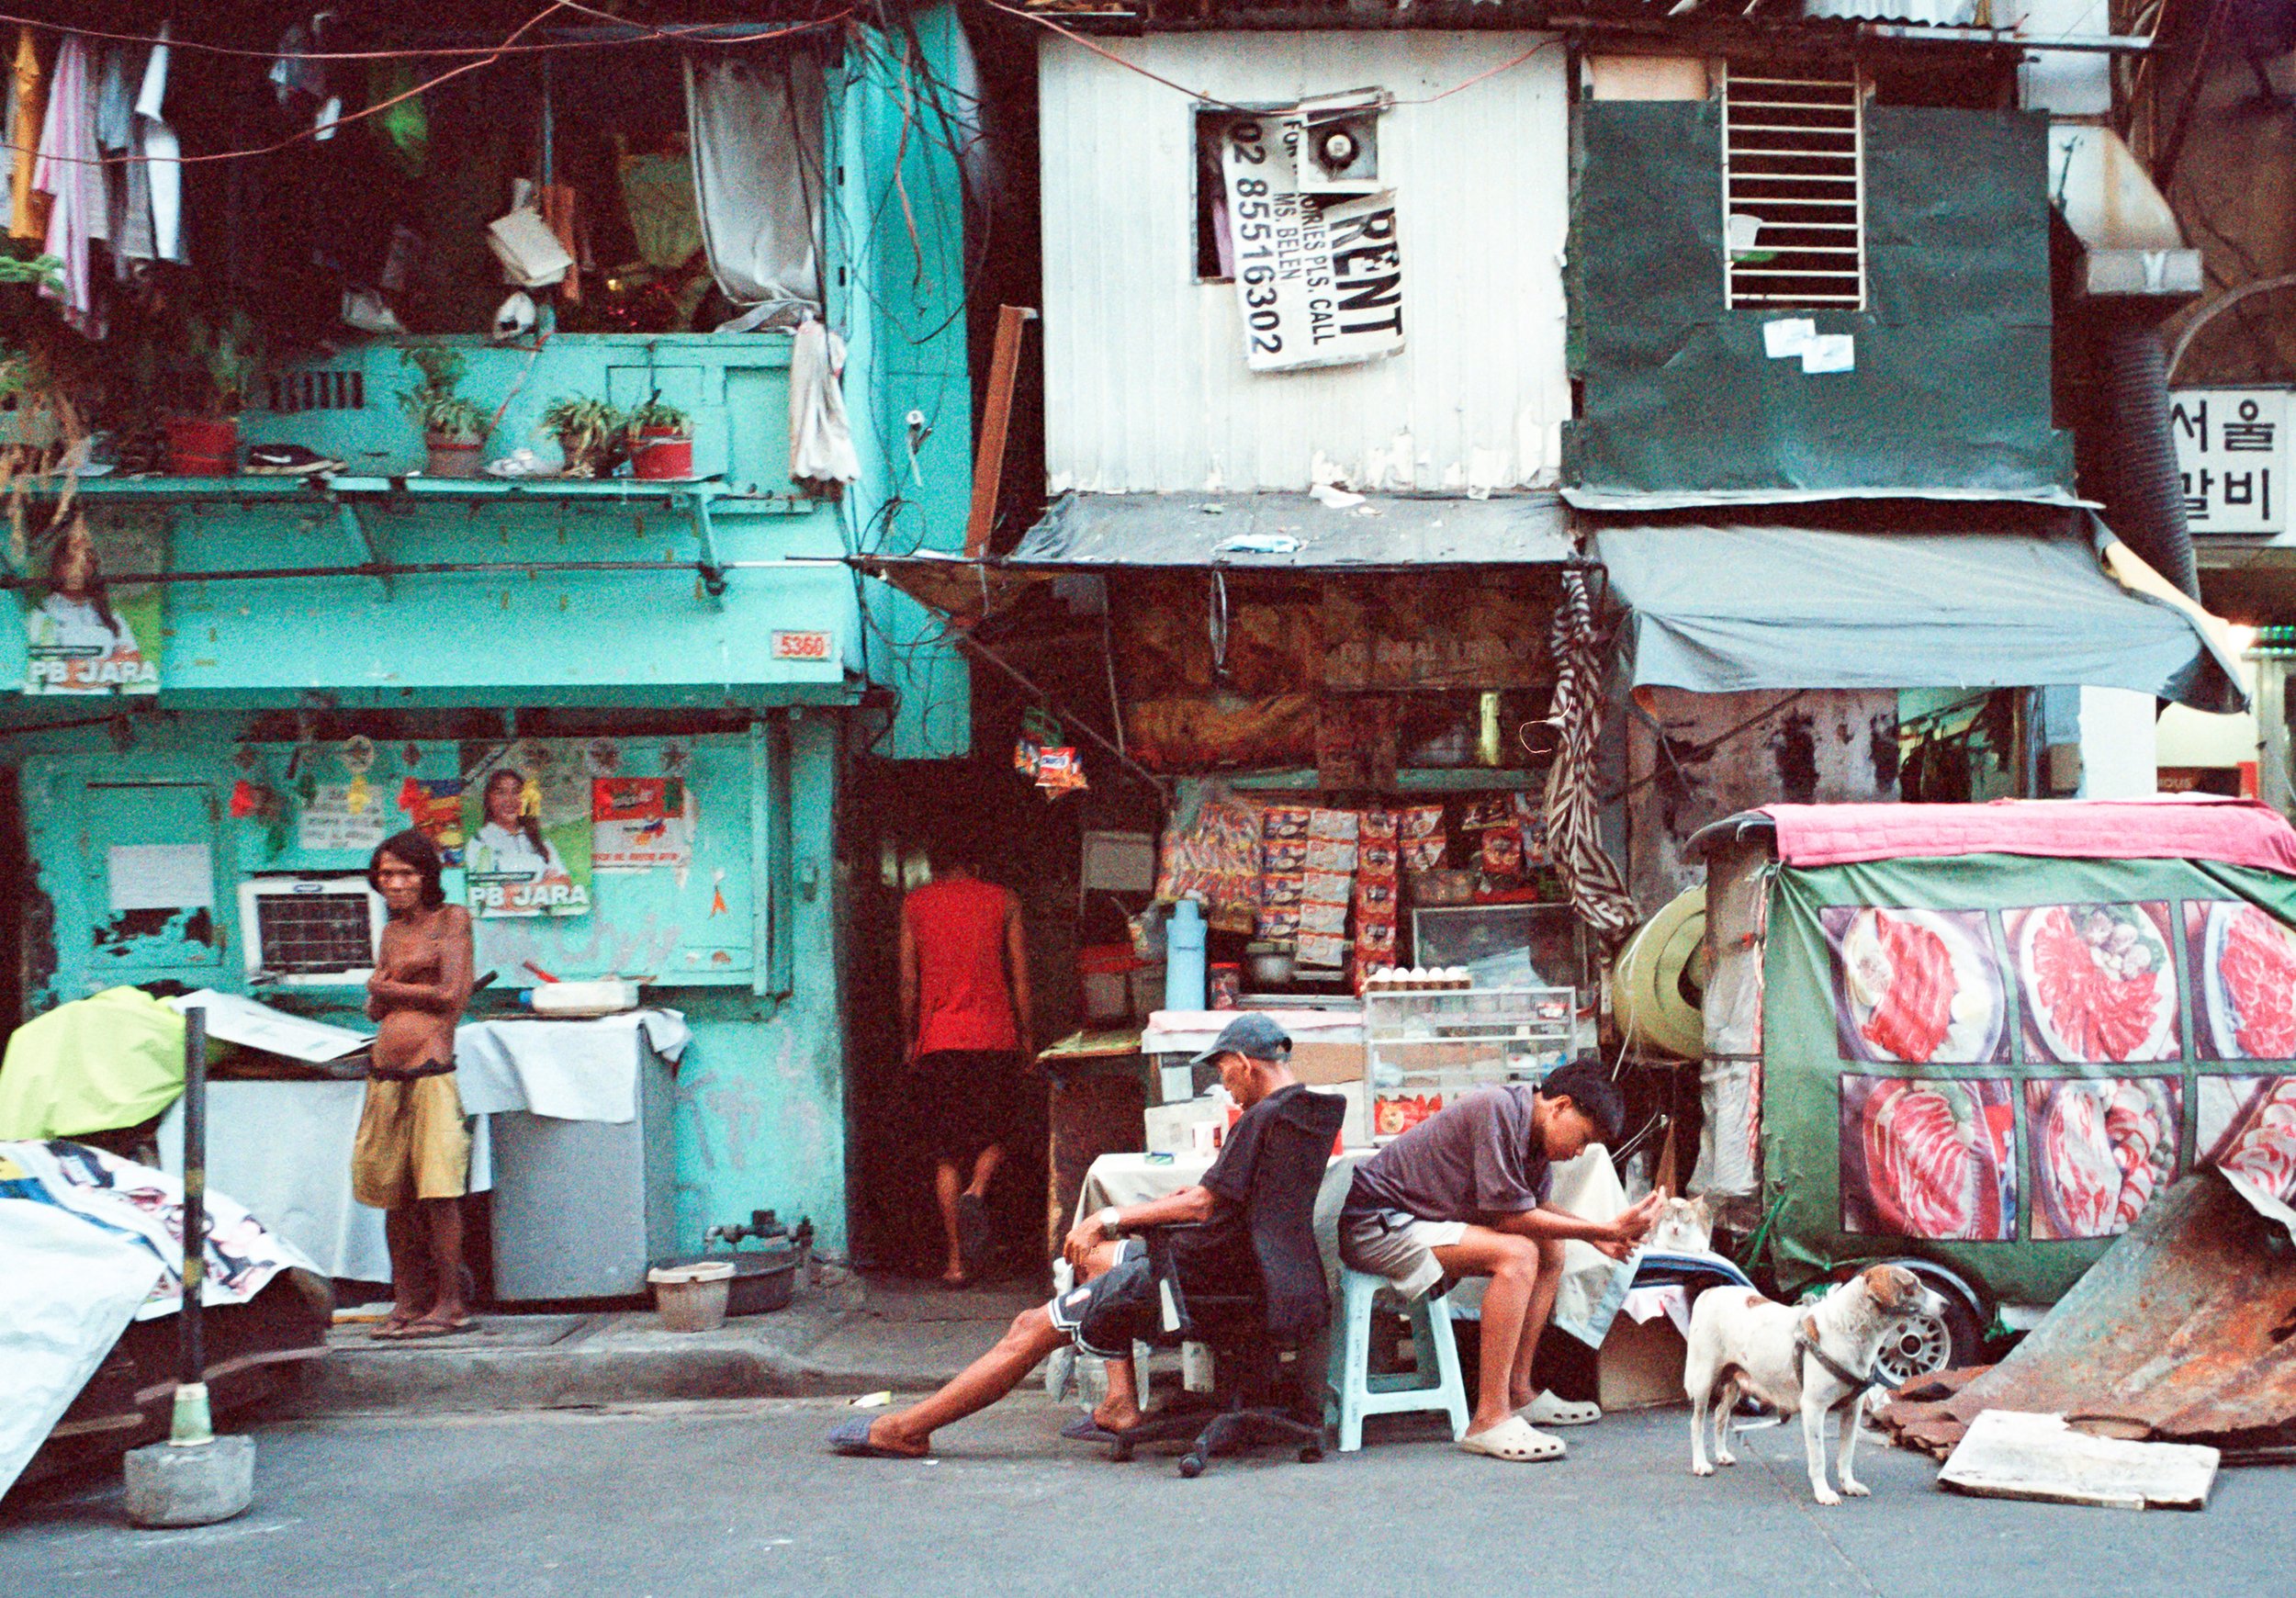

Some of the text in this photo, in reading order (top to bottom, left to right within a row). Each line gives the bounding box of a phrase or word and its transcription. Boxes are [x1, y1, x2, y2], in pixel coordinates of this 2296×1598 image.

[1231, 121, 1283, 354] 02 85516302
[1273, 193, 1301, 281] MS. BELEN
[1305, 257, 1329, 292] PLS.
[1330, 208, 1403, 336] RENT
[1310, 298, 1334, 345] CALL
[2172, 399, 2276, 452] 서울
[782, 636, 824, 656] 5360
[29, 659, 158, 683] PB JARA
[469, 884, 590, 906] PB JARA
